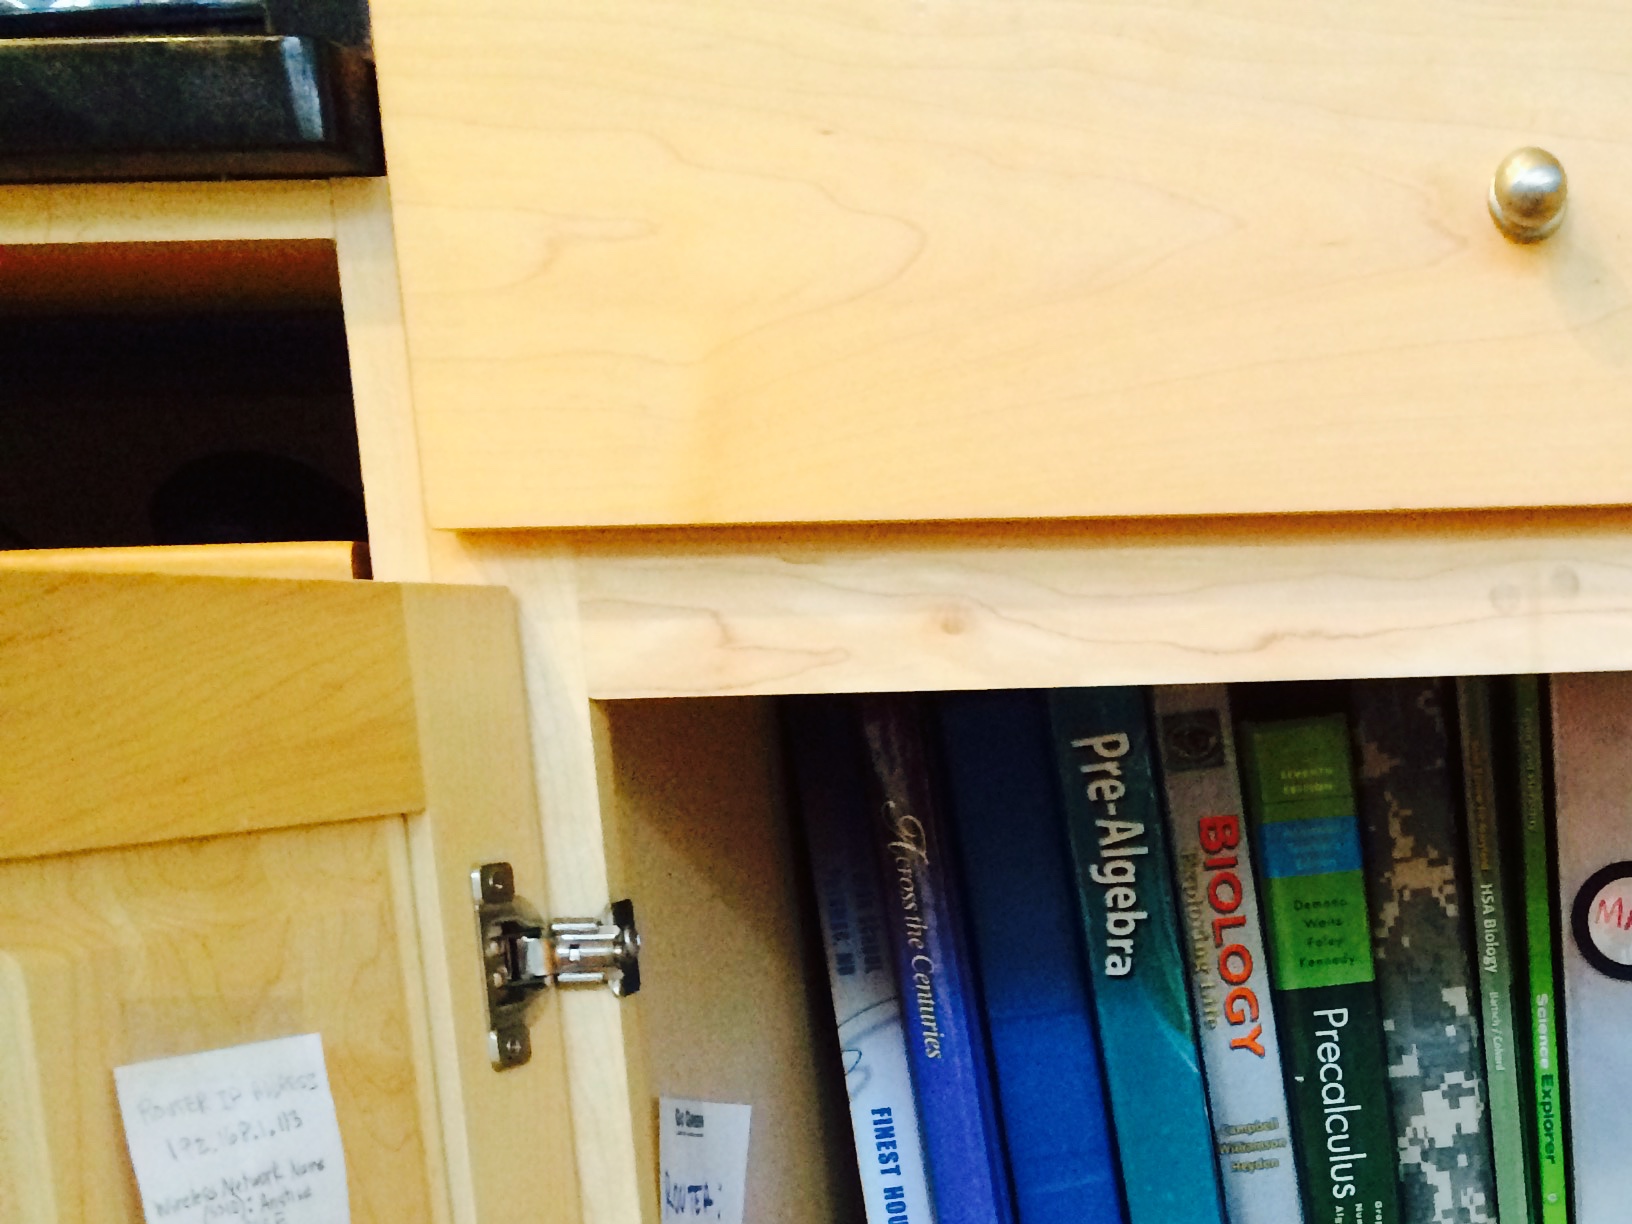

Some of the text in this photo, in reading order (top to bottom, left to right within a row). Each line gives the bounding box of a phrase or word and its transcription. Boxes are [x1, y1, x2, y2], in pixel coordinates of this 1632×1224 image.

[882, 800, 946, 1060] Across the Centuries
[1071, 732, 1149, 977] Pre-Algebra
[1198, 815, 1266, 1058] BIOLOGY
[1480, 883, 1496, 915] HSA
[1483, 918, 1498, 975] Biology
[871, 1106, 902, 1177] FINEST
[1312, 1006, 1368, 1200] Precalculus
[1535, 992, 1556, 1165] Science Explorer
